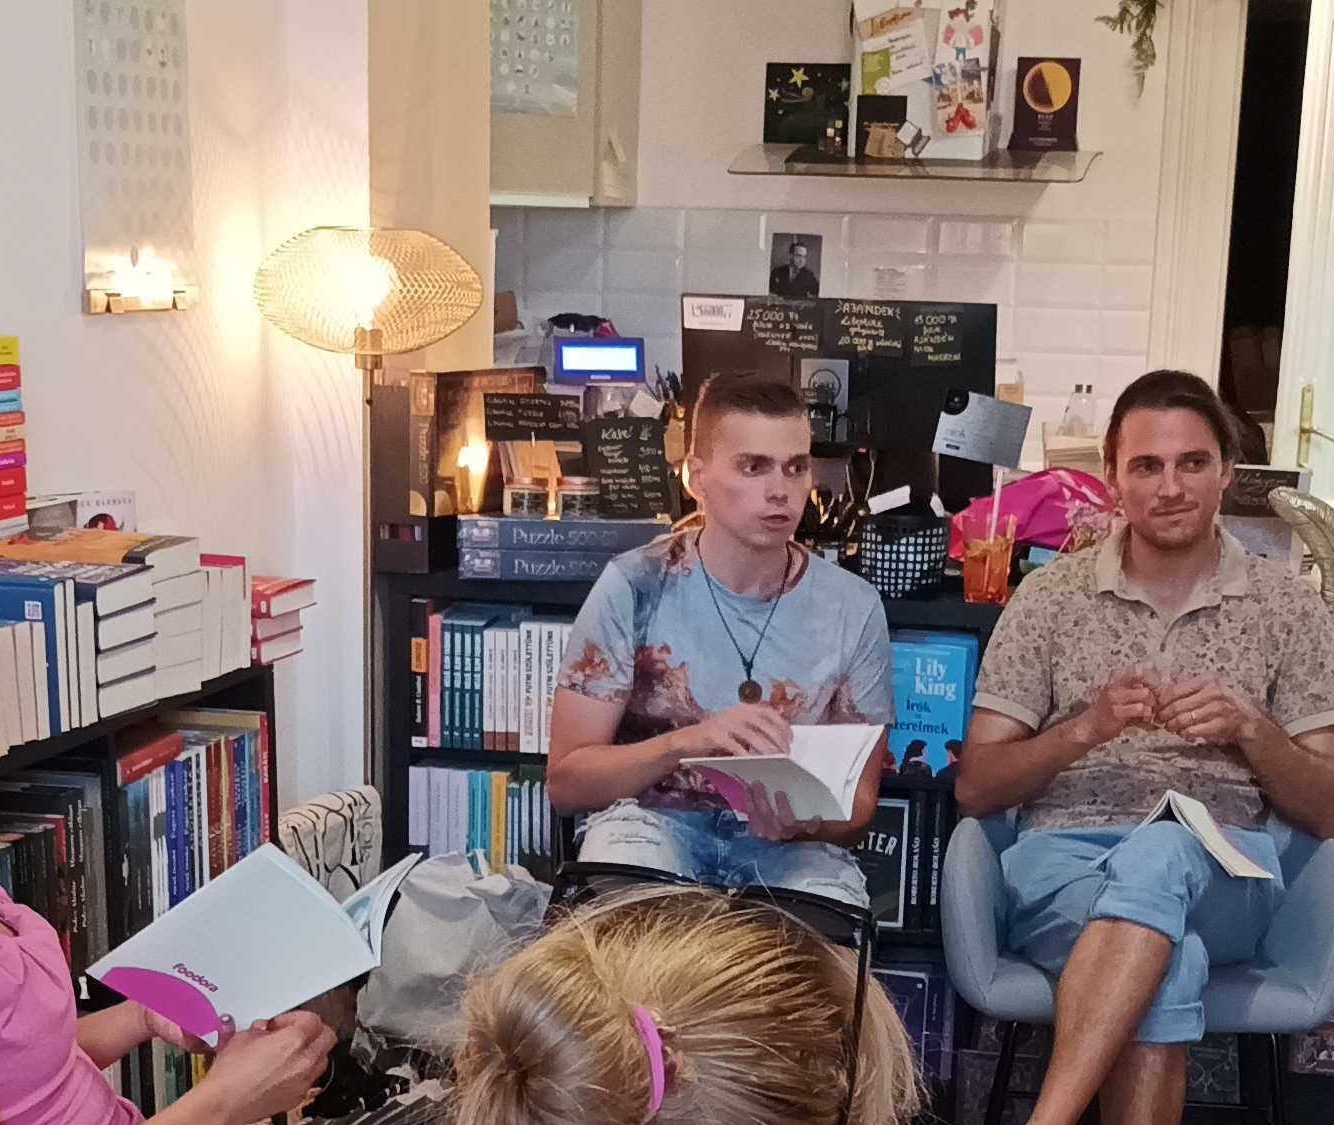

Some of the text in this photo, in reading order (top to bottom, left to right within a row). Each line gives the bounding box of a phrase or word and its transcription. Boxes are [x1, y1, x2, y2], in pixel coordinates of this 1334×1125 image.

[512, 527, 564, 545] Puzzle
[514, 559, 565, 576] Puzzle
[915, 656, 948, 680] Lily
[915, 675, 957, 702] King
[171, 962, 221, 993] foodora
